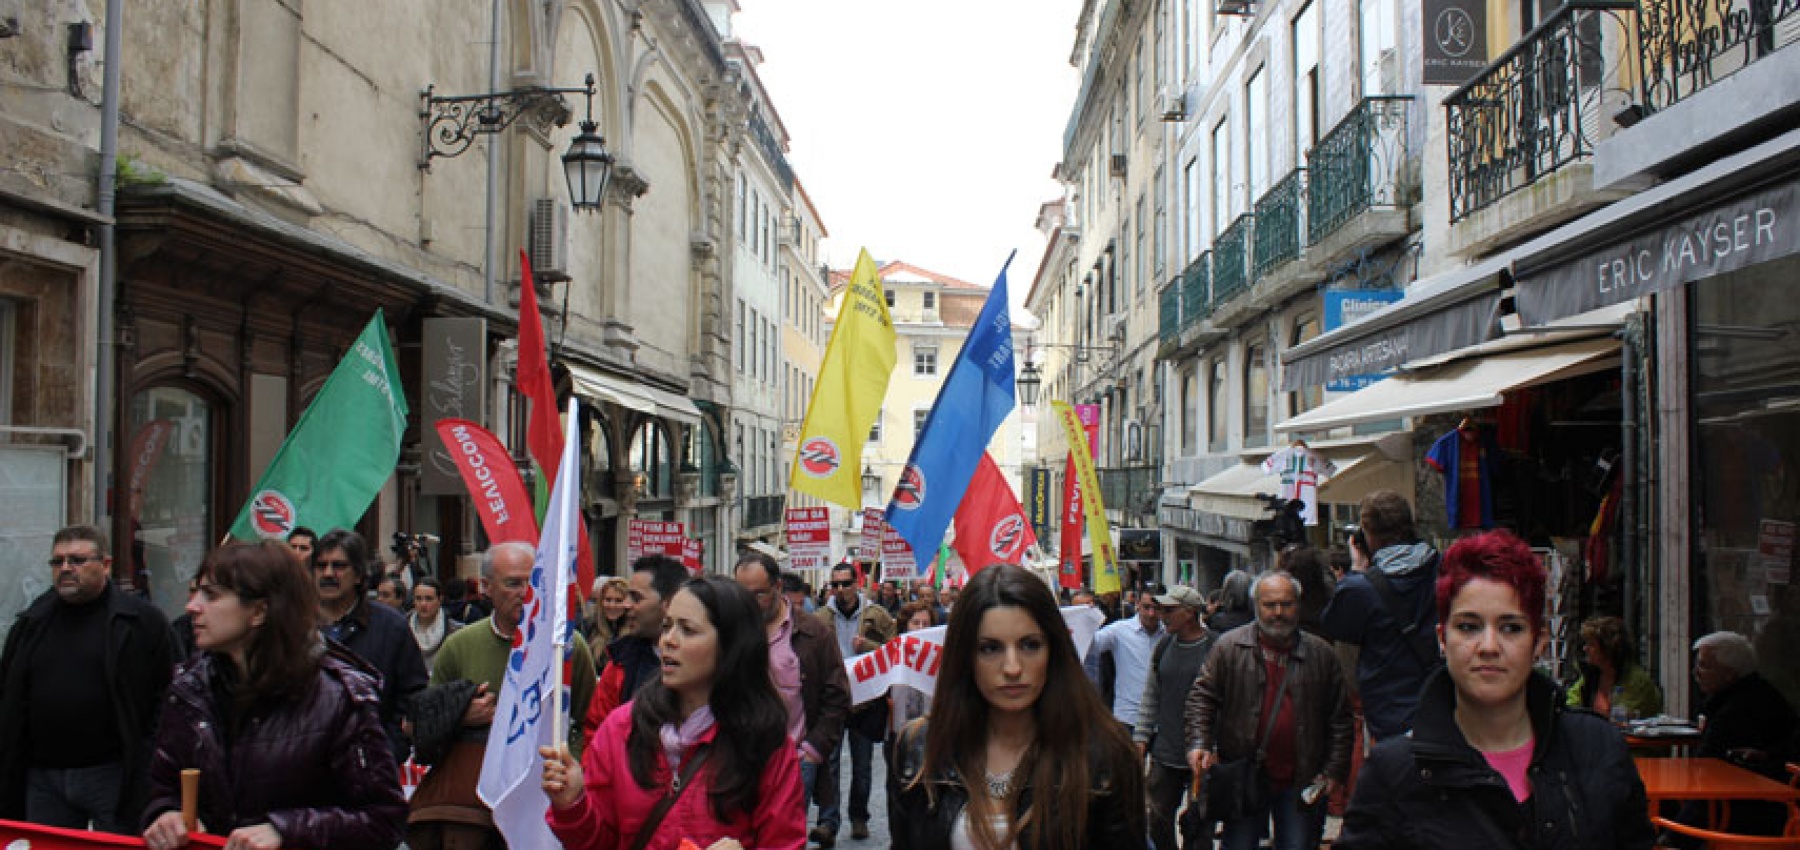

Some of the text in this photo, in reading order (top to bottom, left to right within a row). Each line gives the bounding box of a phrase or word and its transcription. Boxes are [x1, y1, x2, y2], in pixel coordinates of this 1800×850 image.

[1600, 207, 1776, 293] ERIC KAYSER
[788, 509, 826, 520] FIM DA
[643, 523, 679, 533] FIM DA
[791, 557, 818, 568] SIM!
